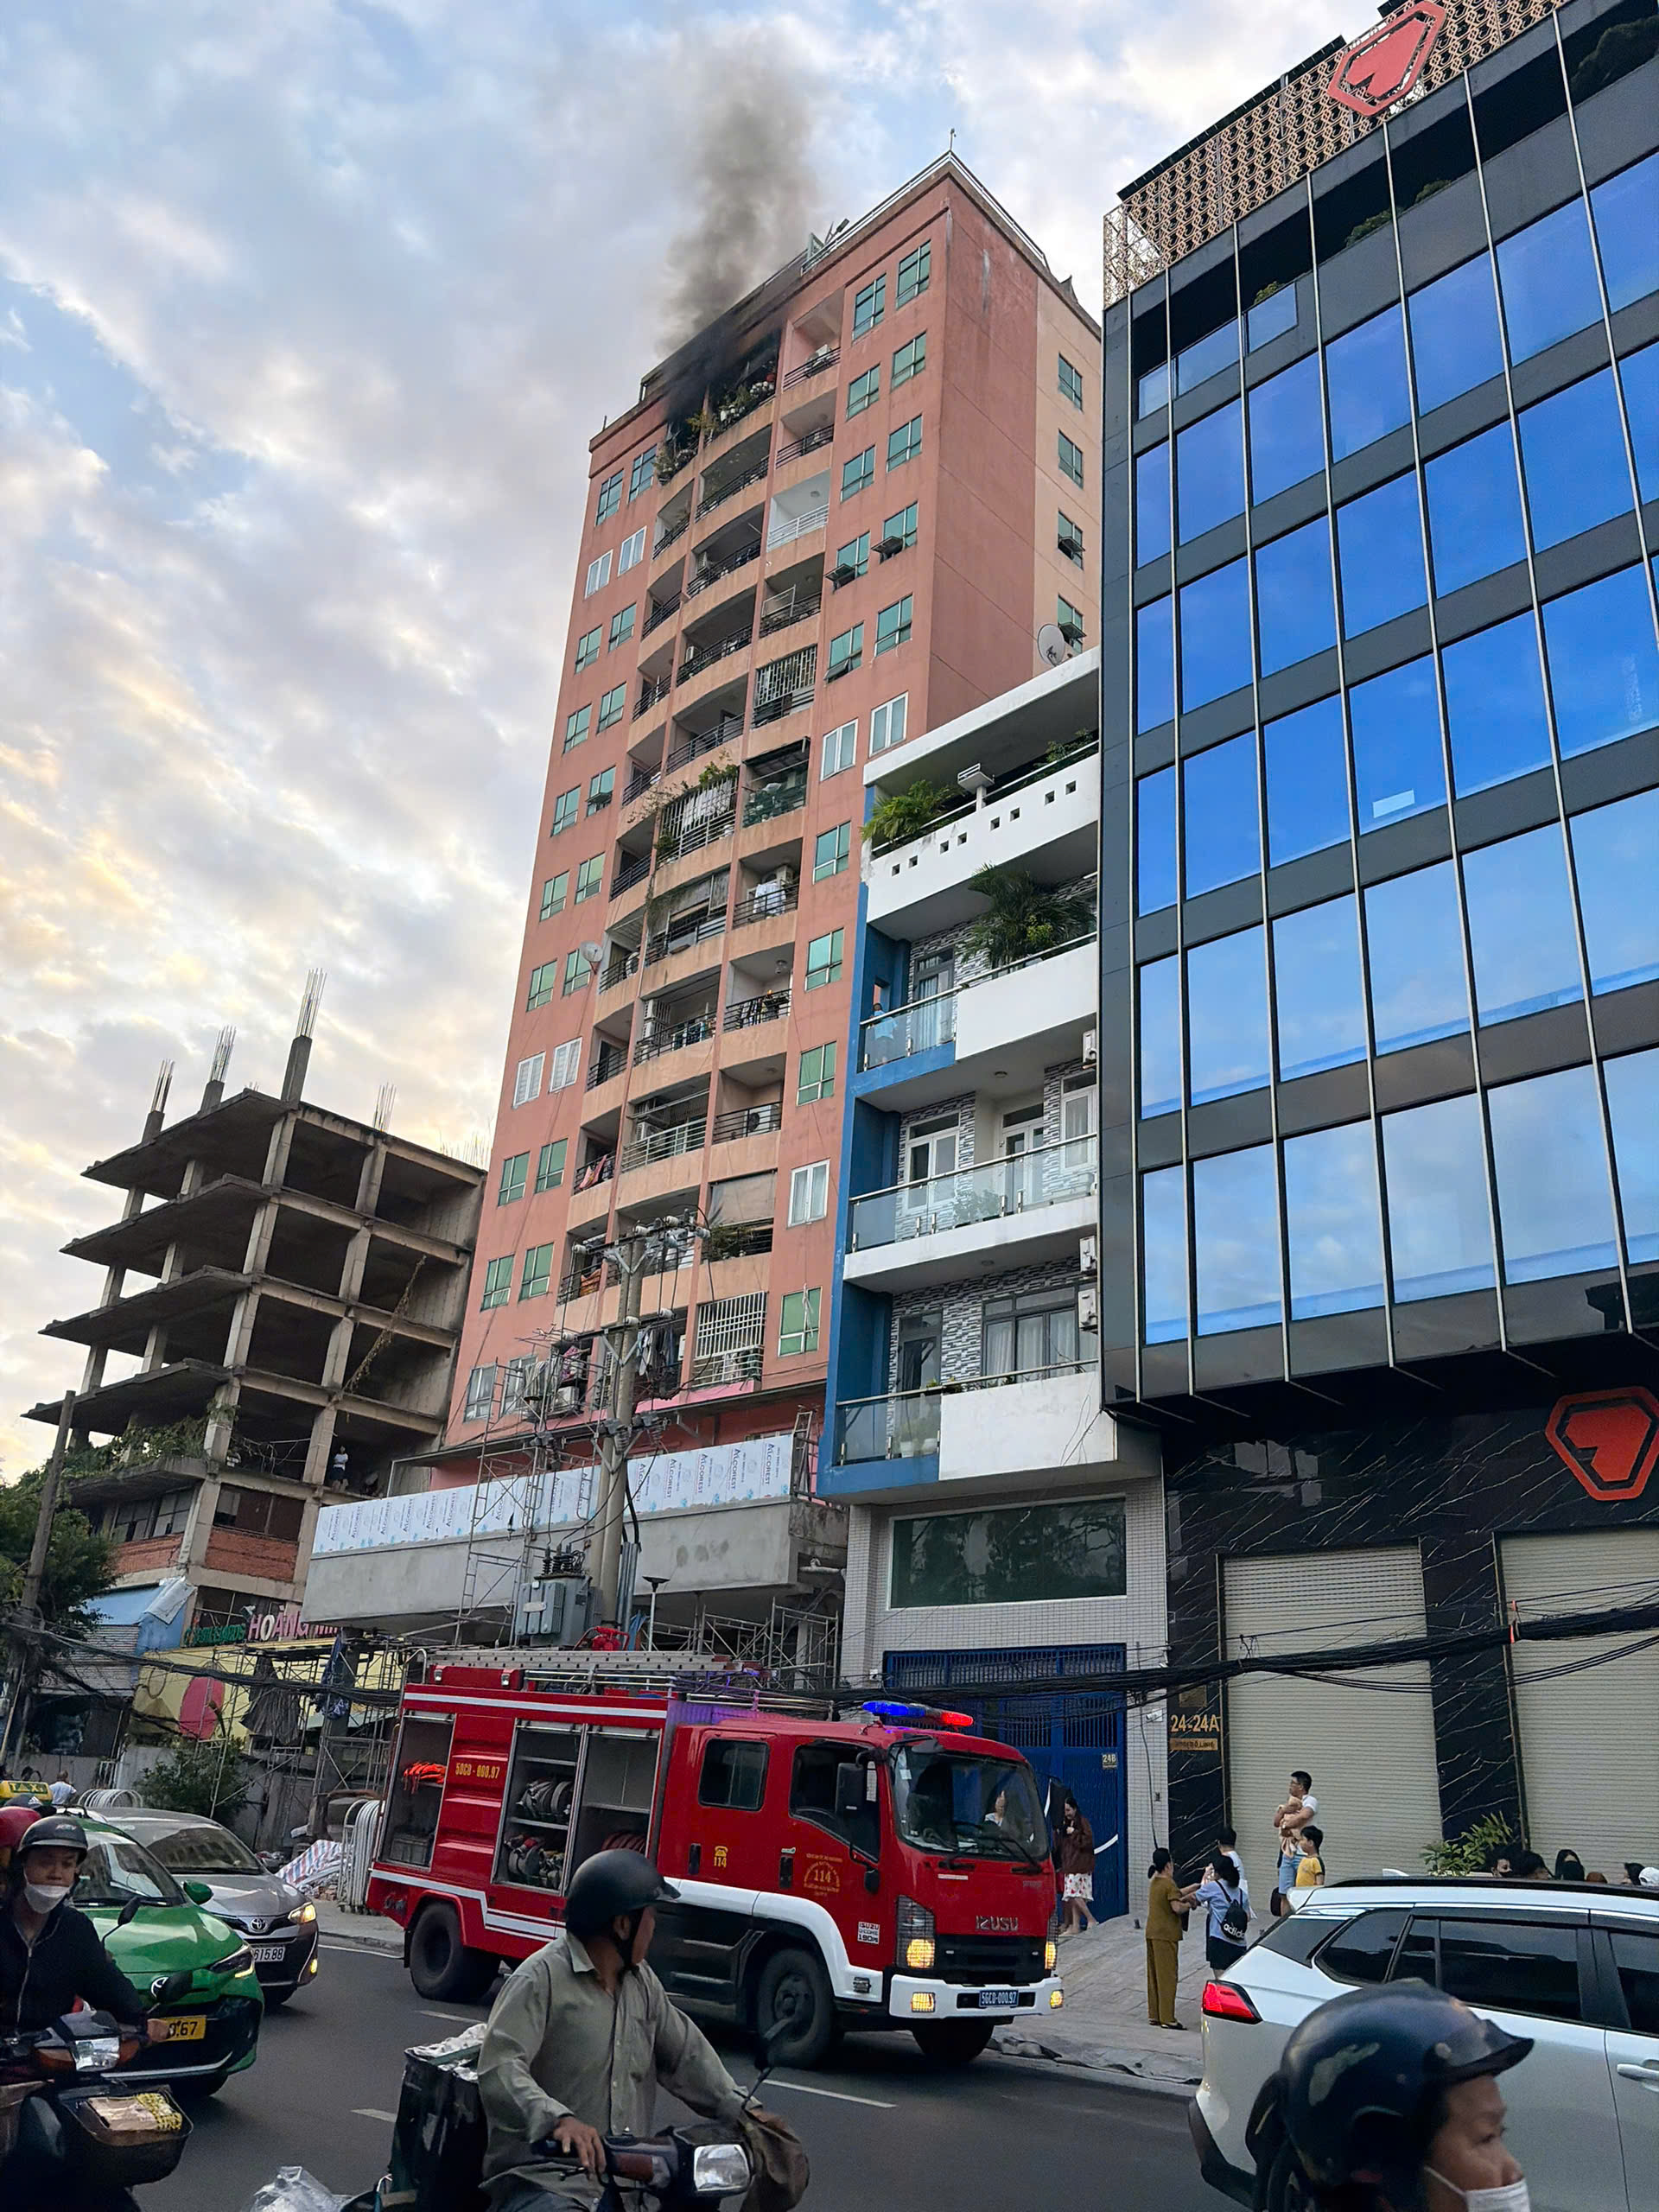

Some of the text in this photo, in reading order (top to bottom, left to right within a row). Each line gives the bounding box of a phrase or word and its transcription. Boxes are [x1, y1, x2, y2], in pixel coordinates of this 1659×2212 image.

[714, 1856, 727, 1867] 114
[814, 1870, 830, 1883] 114
[1223, 1922, 1245, 1938] adid
